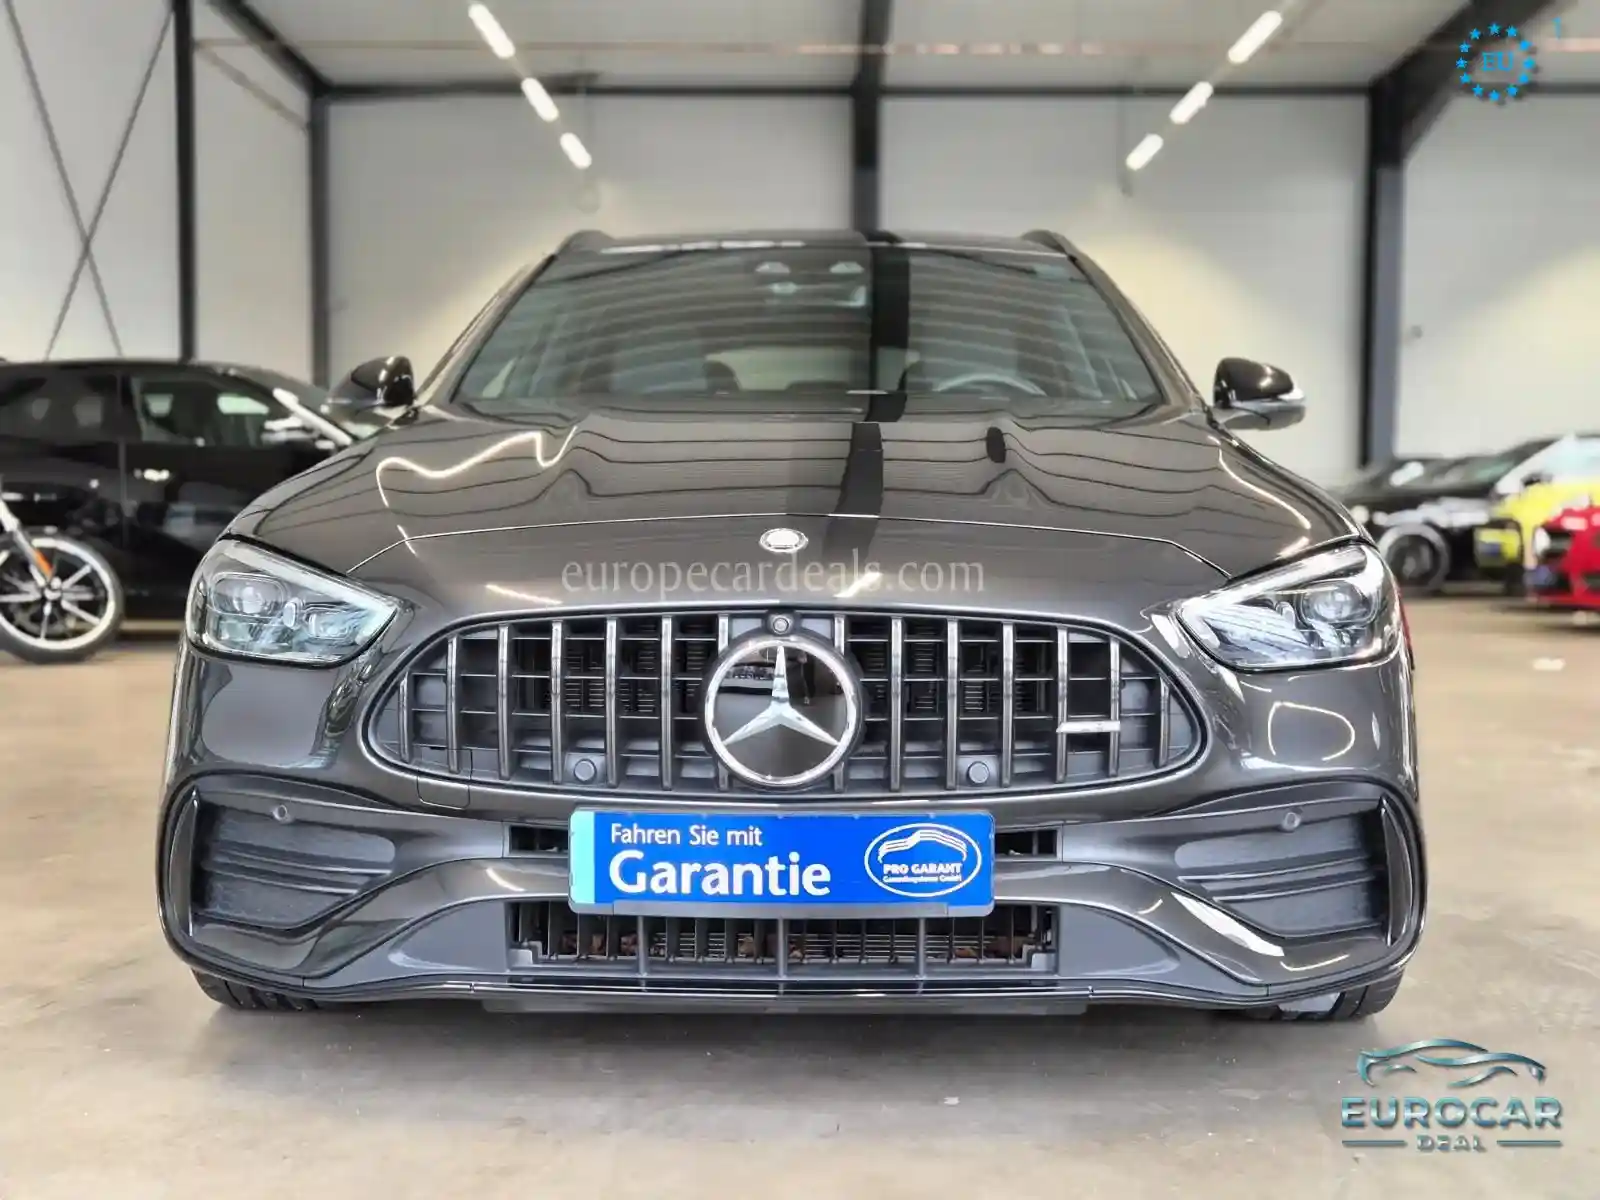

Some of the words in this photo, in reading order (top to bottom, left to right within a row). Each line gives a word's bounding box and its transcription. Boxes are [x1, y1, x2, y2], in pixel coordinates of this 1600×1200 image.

[610, 823, 681, 846] Fahren
[689, 824, 719, 847] Sie
[727, 827, 763, 846] mit
[609, 849, 832, 897] Garantie
[883, 863, 909, 875] PRO
[911, 862, 962, 875] GARANT
